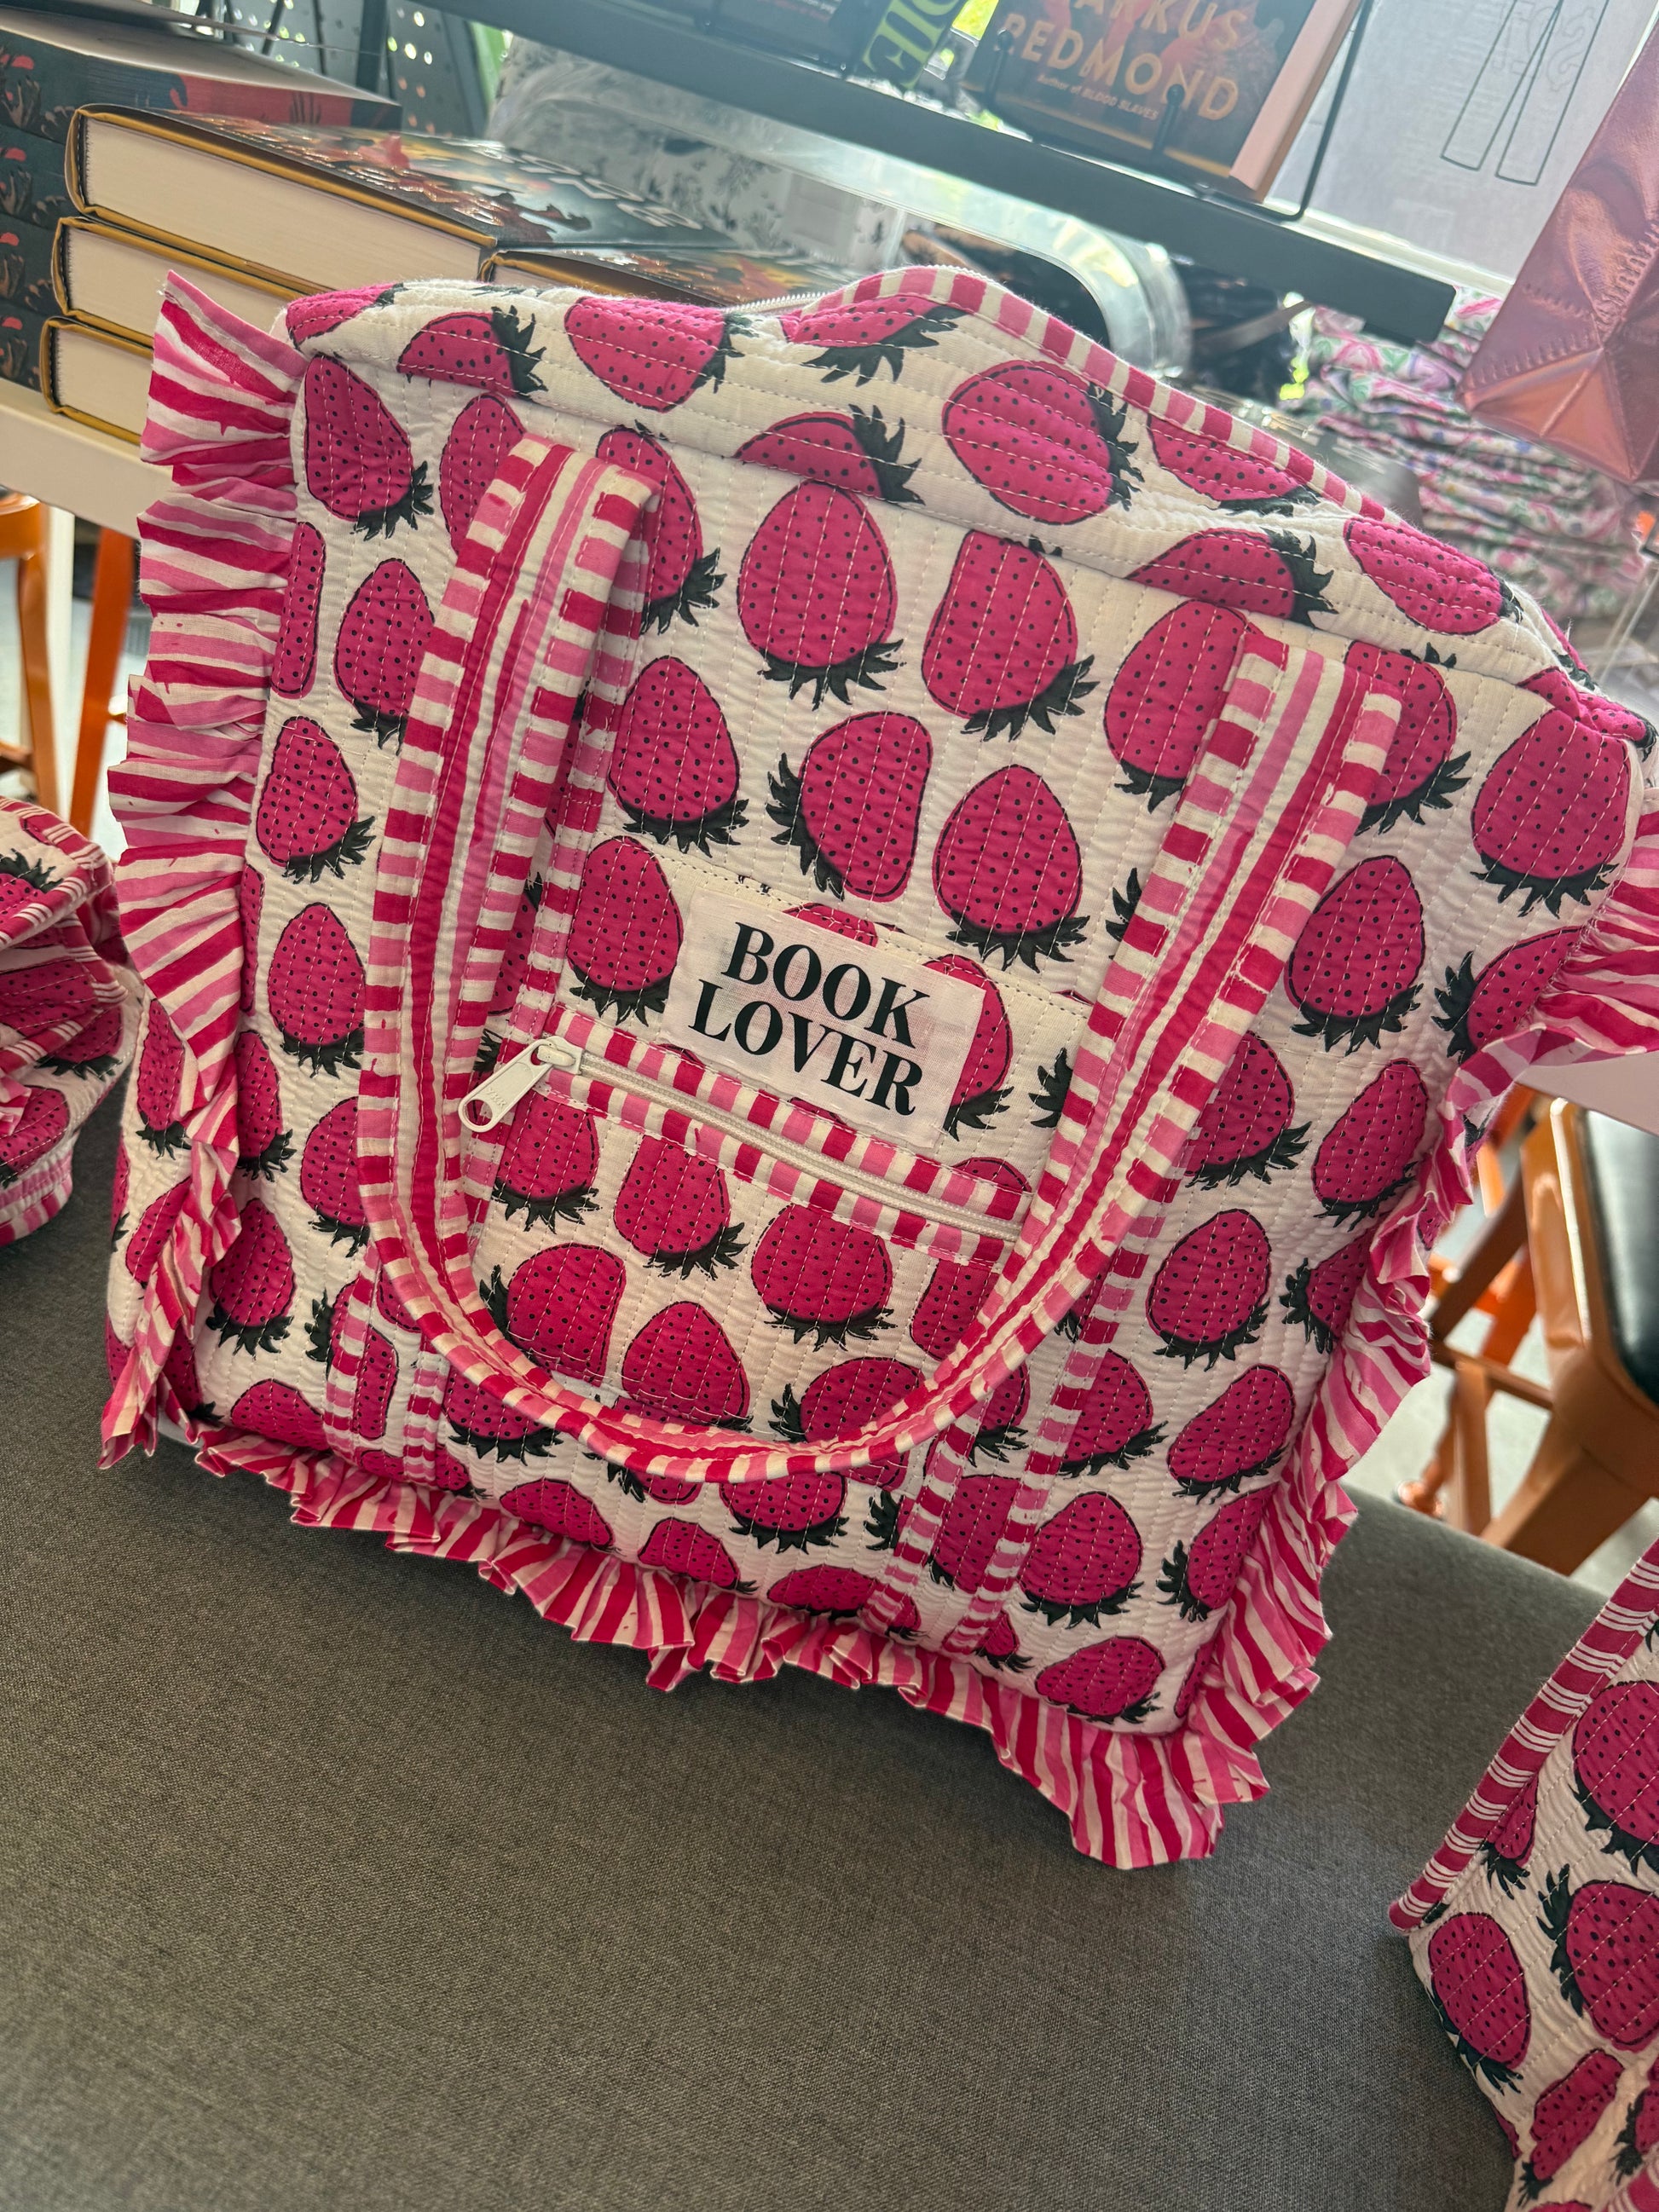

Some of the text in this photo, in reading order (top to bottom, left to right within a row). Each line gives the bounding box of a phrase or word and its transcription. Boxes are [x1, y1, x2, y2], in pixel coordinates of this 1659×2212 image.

[1073, 0, 1247, 51] RKUS
[688, 979, 923, 1116] LOVER
[720, 921, 930, 1049] BOOK
